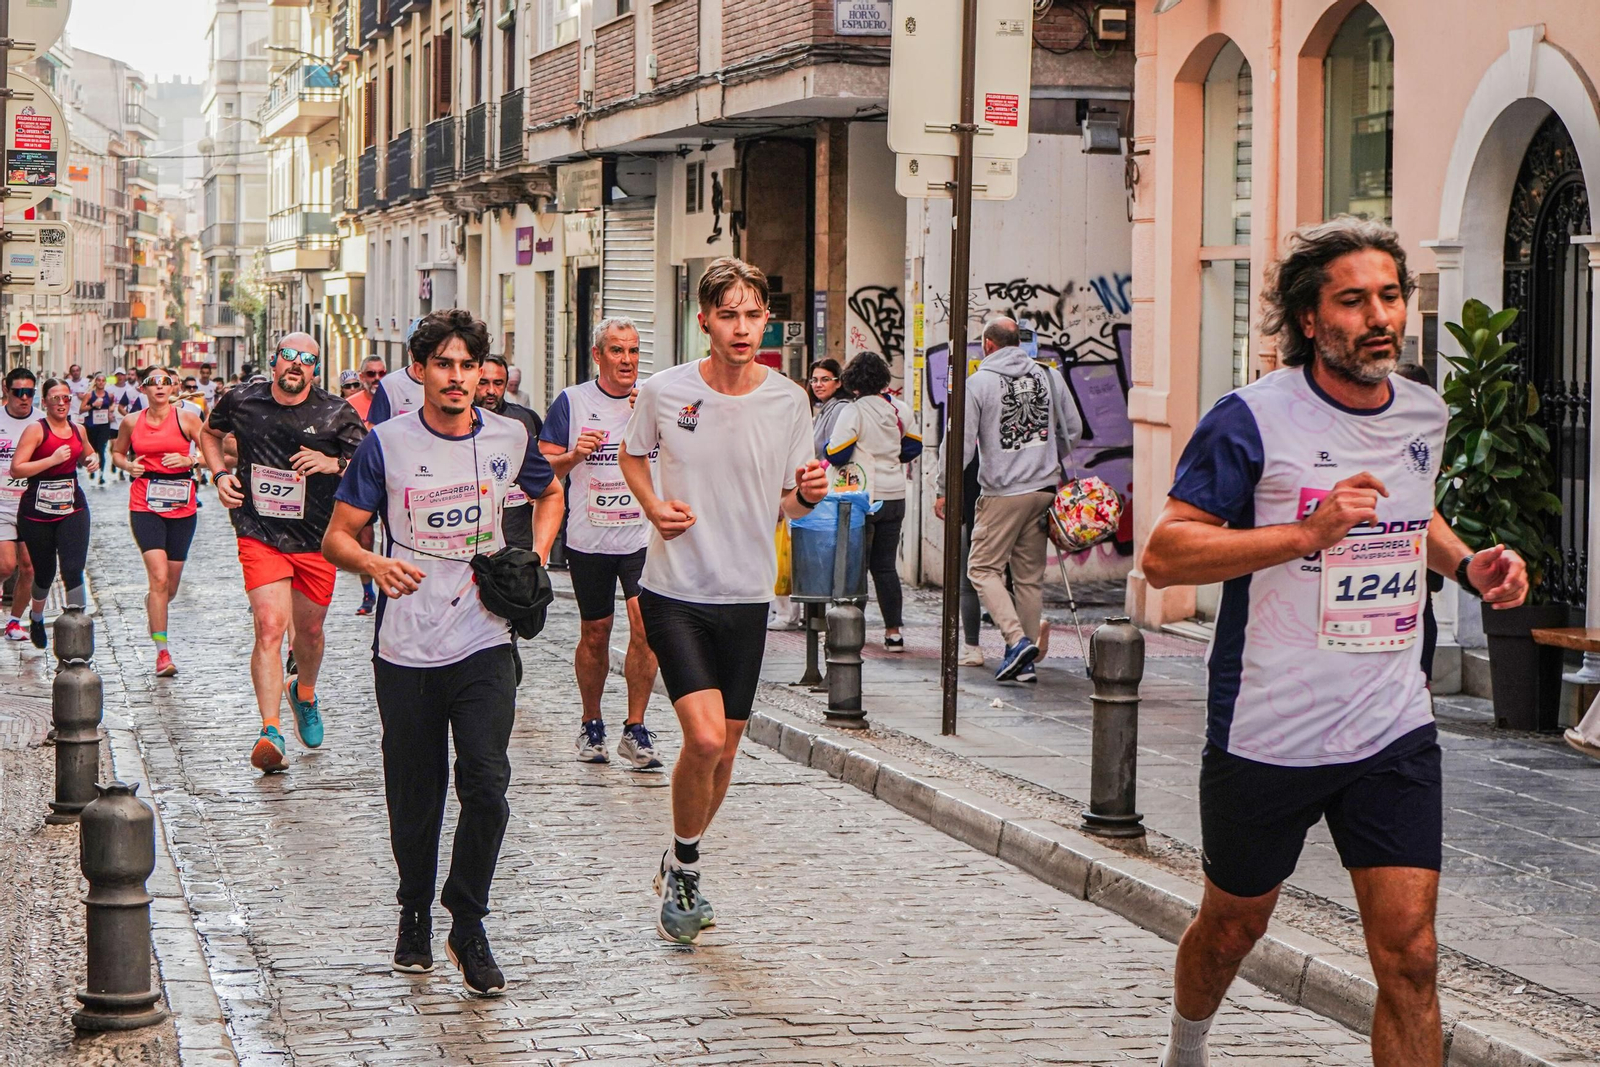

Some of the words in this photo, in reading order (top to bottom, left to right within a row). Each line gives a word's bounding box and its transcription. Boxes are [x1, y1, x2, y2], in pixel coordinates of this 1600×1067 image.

[849, 10, 881, 20] HORNO
[842, 20, 887, 30] ESPADERO
[678, 416, 697, 424] 400
[151, 486, 186, 499] 1302
[259, 482, 294, 497] 937
[429, 484, 475, 499] CARRERA
[596, 494, 631, 507] 670
[427, 505, 482, 528] 690
[1351, 539, 1411, 552] CARRERA
[1335, 570, 1417, 601] 1244
